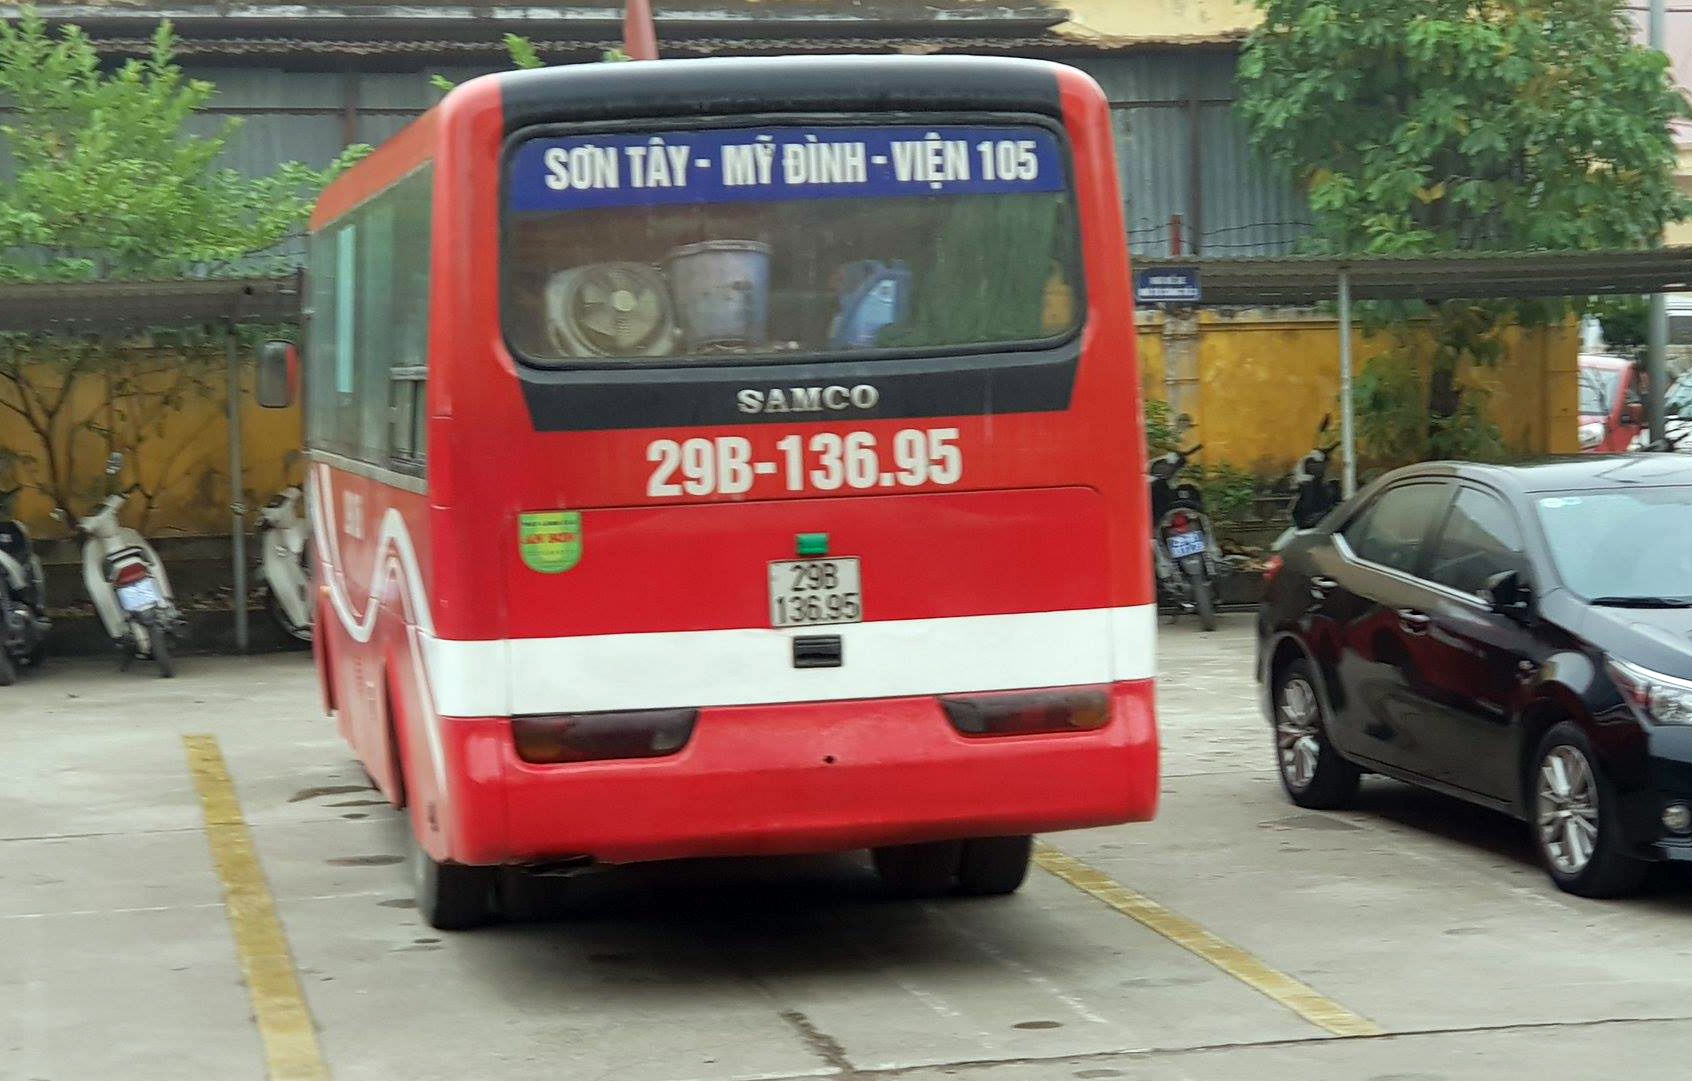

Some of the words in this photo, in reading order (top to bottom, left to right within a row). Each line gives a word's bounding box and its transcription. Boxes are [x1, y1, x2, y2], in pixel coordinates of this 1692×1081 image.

[543, 144, 619, 190] SƠN
[625, 137, 691, 187] TÂY
[721, 134, 776, 185] MỸ
[782, 134, 866, 184] ĐÌNH
[891, 132, 970, 189] VIỆN
[976, 141, 1038, 182] 105
[737, 384, 880, 413] SAMCO
[646, 428, 963, 497] 29B-136.95
[790, 563, 839, 592] 29B
